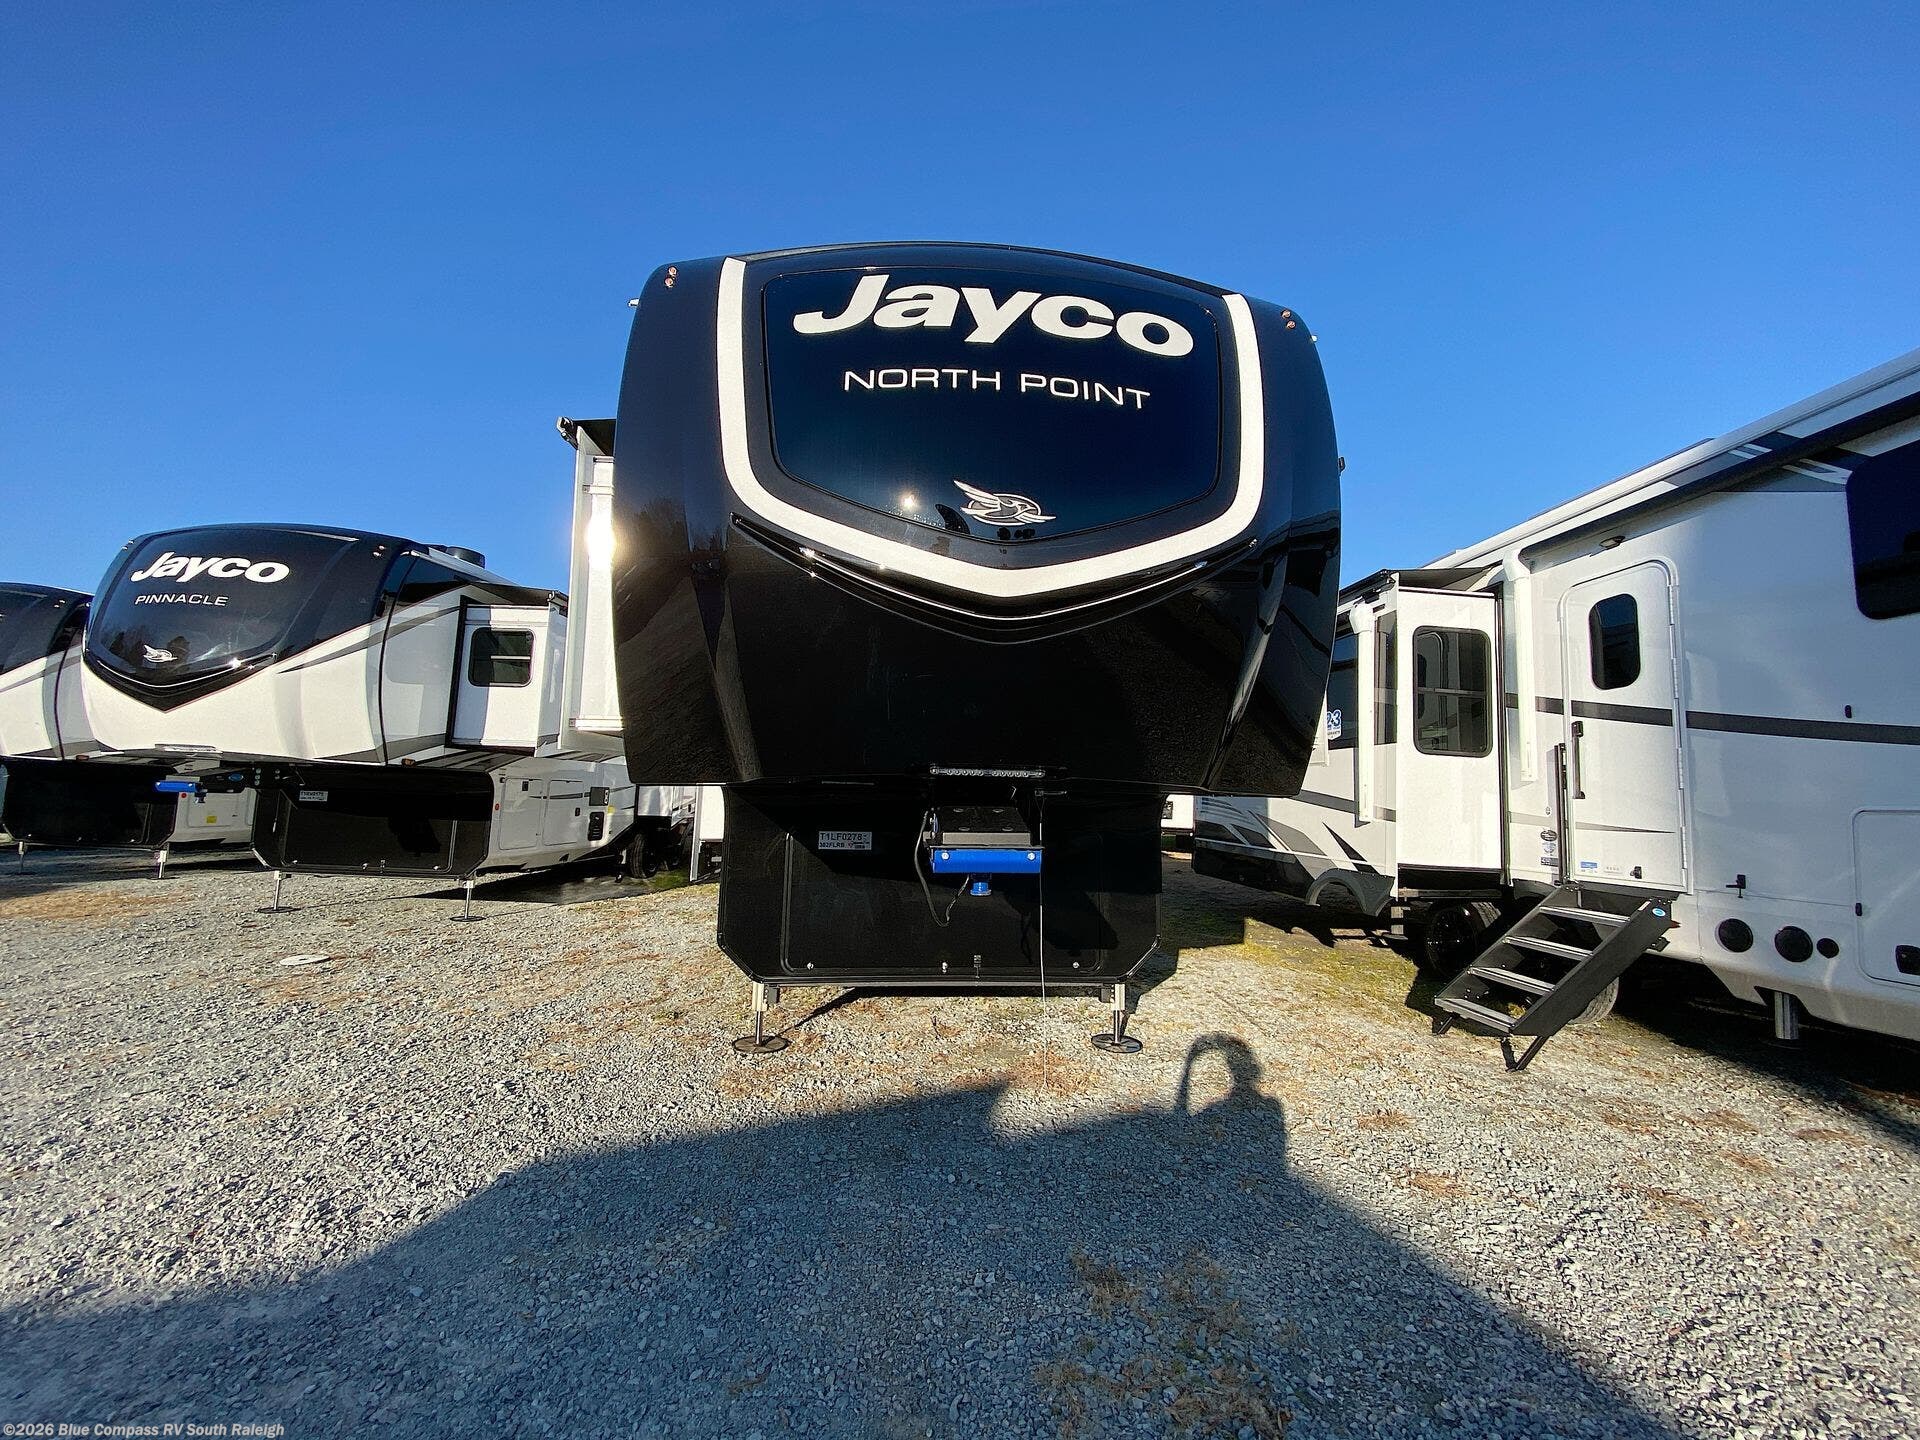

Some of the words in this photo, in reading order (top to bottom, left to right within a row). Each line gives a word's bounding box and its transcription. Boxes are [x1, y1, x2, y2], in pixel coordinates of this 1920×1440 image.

[793, 274, 1194, 358] Jayco
[844, 367, 1002, 392] NORTH
[1019, 372, 1152, 410] POINT
[130, 551, 290, 583] Jayco
[134, 593, 229, 607] PINNACLE
